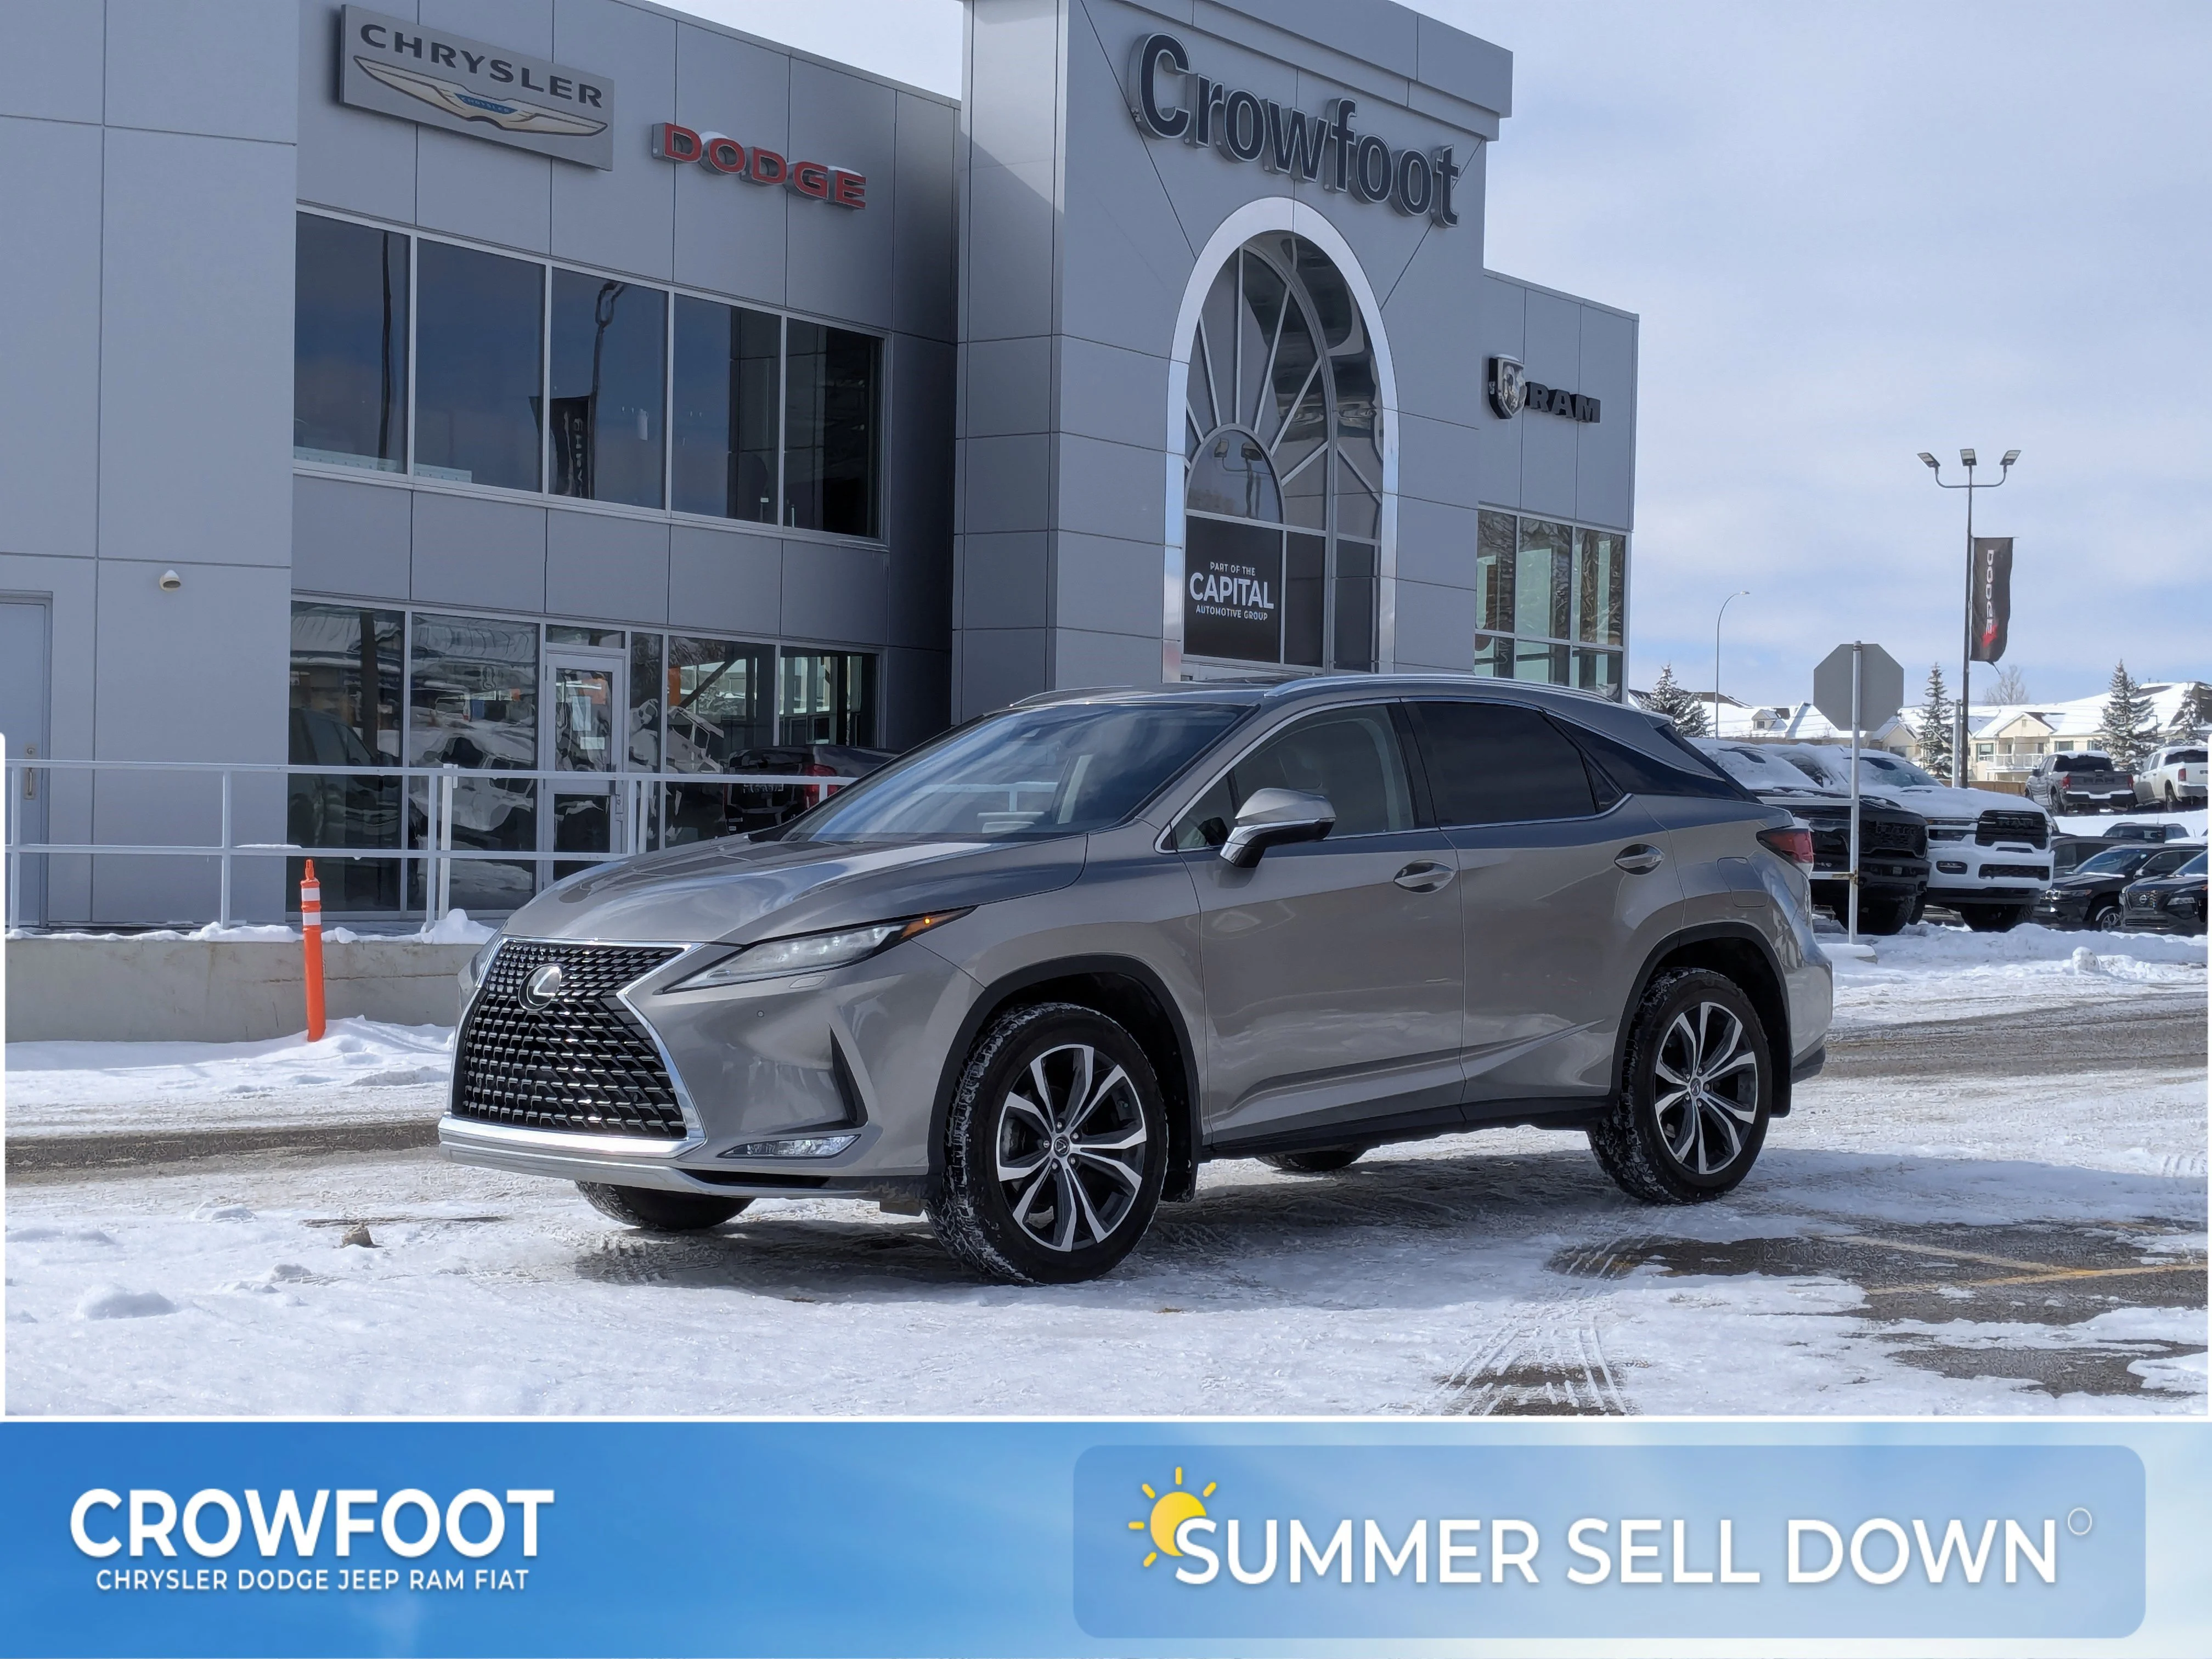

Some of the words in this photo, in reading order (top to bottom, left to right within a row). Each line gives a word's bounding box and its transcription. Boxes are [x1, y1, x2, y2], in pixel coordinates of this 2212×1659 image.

[360, 24, 603, 109] CHRYSLER
[1137, 32, 1460, 227] Crowfoot
[662, 122, 866, 210] DODGE
[1528, 382, 1601, 424] RAM
[1210, 561, 1228, 572] PART
[1231, 565, 1240, 573] OF
[1242, 566, 1256, 576] THE
[1189, 572, 1274, 609] CAPITAL
[1195, 604, 1242, 618] AUTOMOTIVE
[1244, 610, 1268, 620] GROUP
